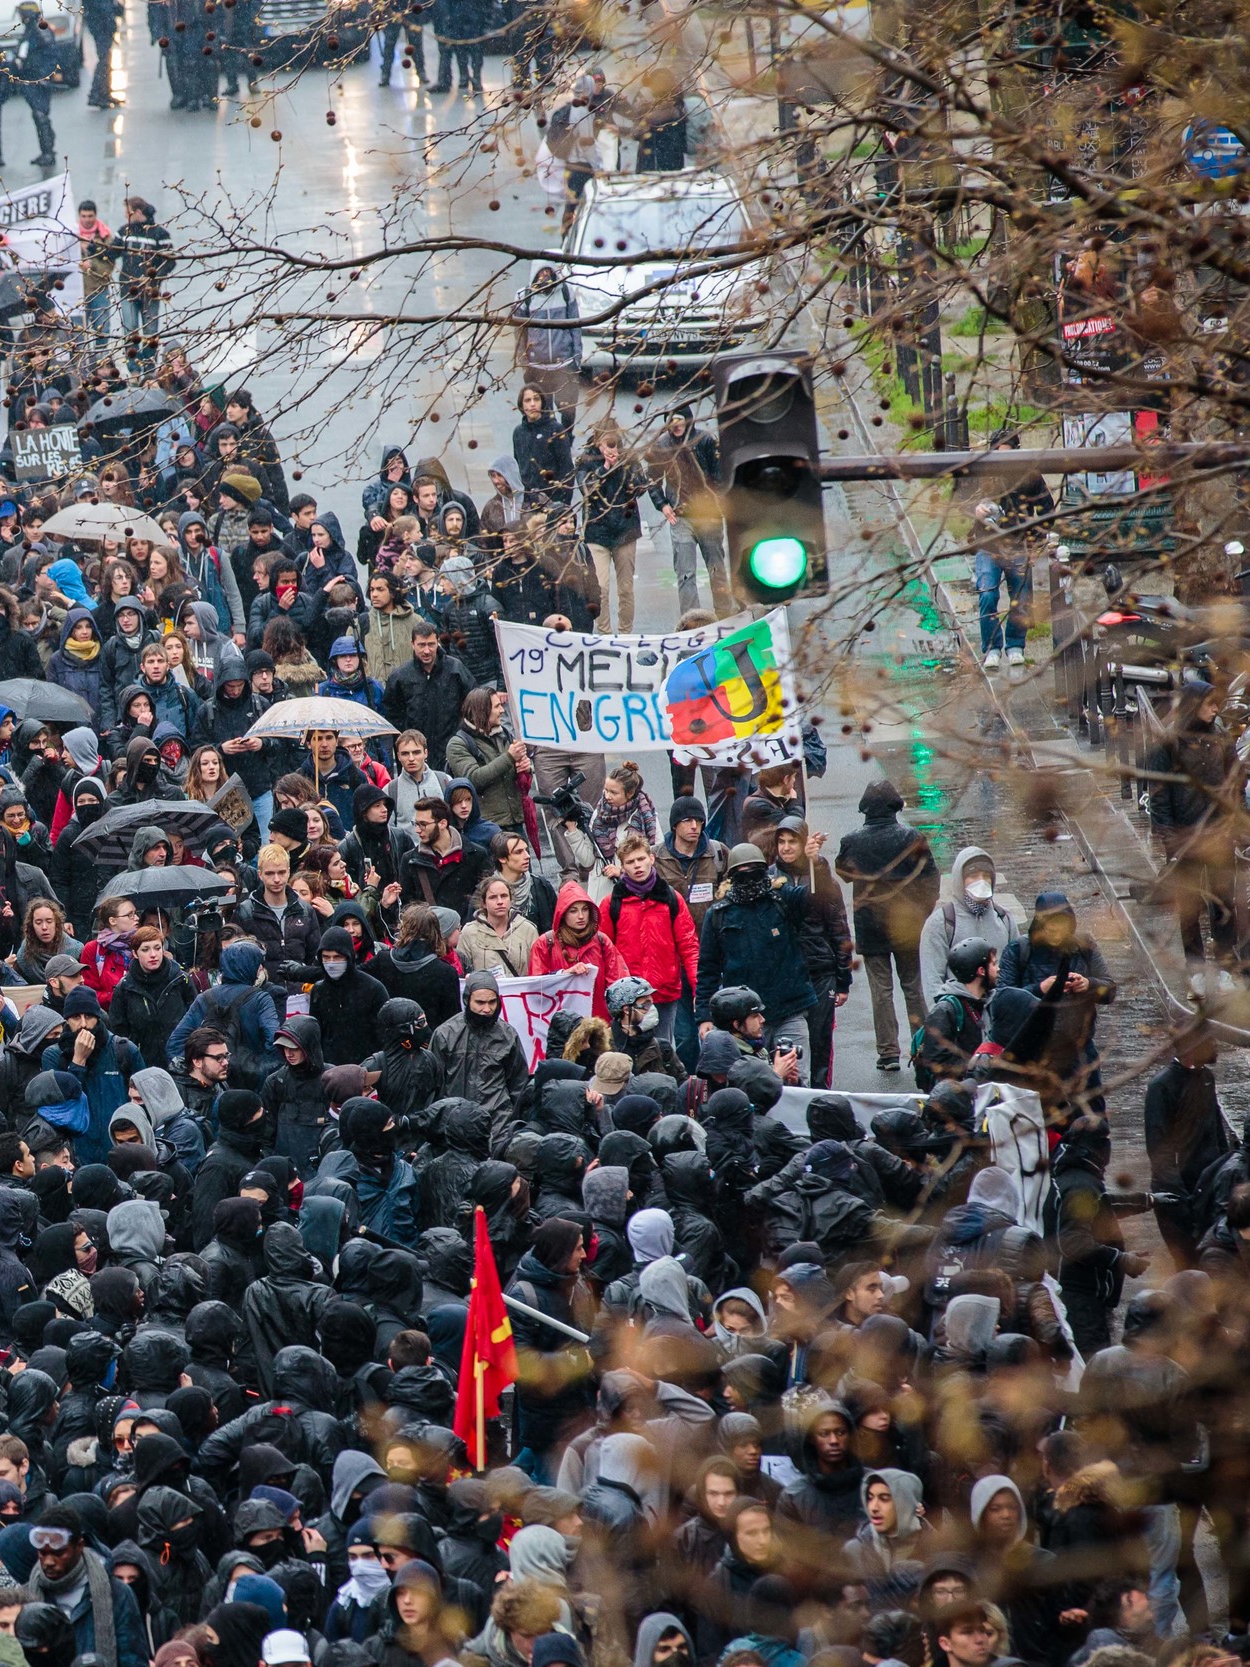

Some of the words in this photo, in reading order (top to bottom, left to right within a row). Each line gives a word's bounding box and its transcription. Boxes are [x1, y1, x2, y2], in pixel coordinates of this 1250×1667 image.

[15, 434, 38, 455] LA
[39, 426, 81, 452] HONTE
[15, 453, 41, 468] SUR
[42, 451, 62, 465] LES
[519, 689, 577, 743] EN
